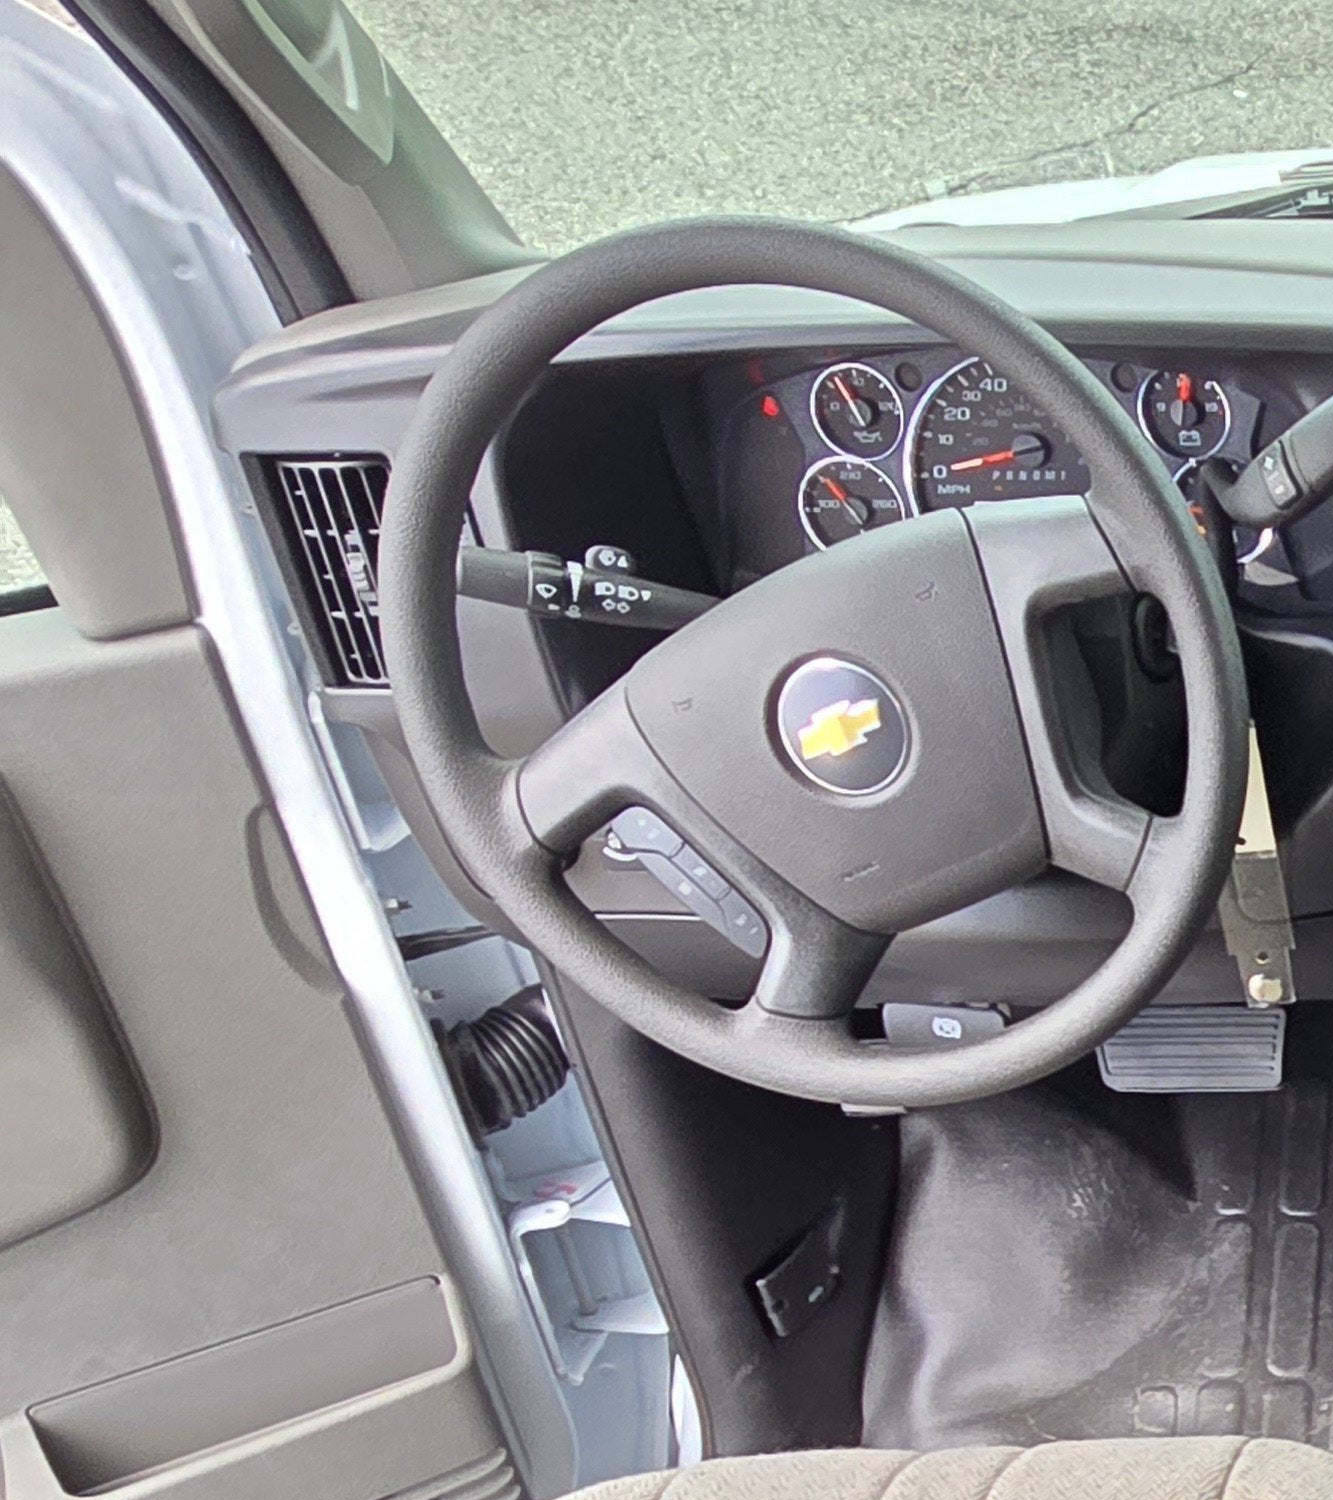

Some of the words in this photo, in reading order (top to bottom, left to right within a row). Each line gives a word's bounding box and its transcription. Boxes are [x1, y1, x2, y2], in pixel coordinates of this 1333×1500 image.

[979, 378, 1007, 392] 40
[962, 390, 981, 402] 30
[944, 407, 970, 421] 20
[938, 434, 954, 445] 10
[933, 465, 947, 479] 0
[937, 484, 971, 495] MPH
